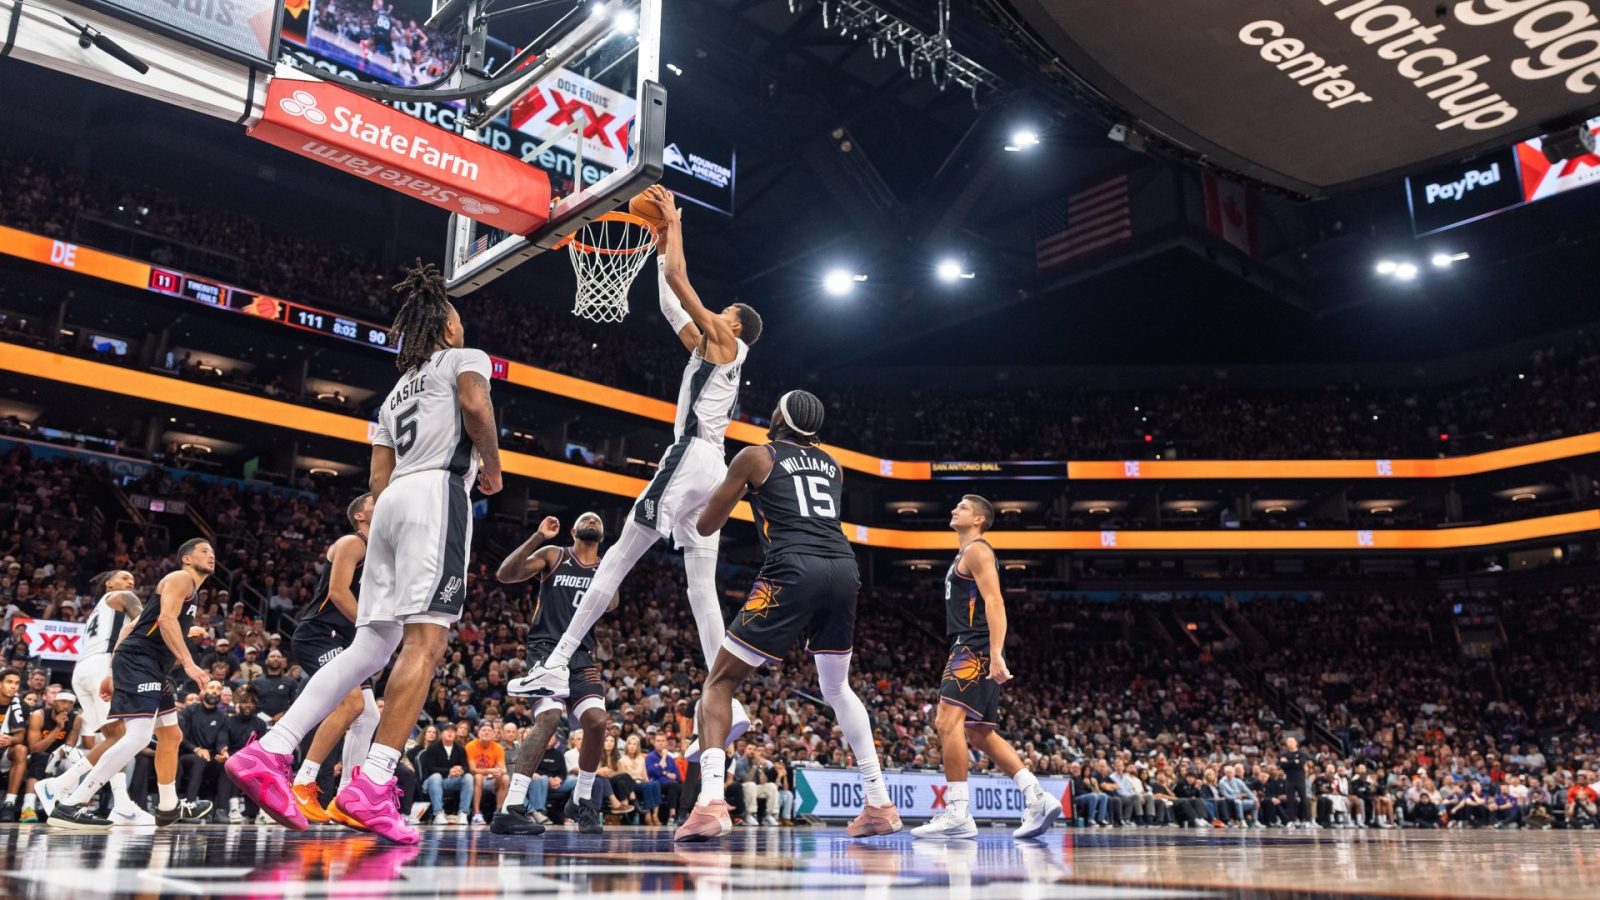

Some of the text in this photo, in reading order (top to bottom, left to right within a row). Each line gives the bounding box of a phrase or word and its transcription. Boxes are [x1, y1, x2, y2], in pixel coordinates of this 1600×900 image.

[1238, 19, 1373, 110] center
[557, 78, 609, 108] DOS EQUIS
[689, 153, 731, 179] MOUNTAIN
[1425, 162, 1501, 205] PayPal
[50, 239, 78, 267] DE
[158, 275, 170, 288] 11
[298, 311, 323, 329] 111
[333, 322, 357, 338] 8:02
[368, 329, 386, 345] 90
[390, 374, 427, 411] CASTLE
[394, 399, 420, 459] 5
[779, 456, 837, 479] WILLIAMS
[880, 459, 893, 476] DE
[1124, 460, 1140, 477] DE
[1376, 459, 1393, 476] DE
[792, 475, 837, 519] 15
[1101, 530, 1117, 547] DE
[1357, 529, 1375, 546] DE
[553, 574, 593, 589] PHOEN
[36, 632, 81, 655] XX
[830, 783, 863, 808] DOS
[975, 787, 1003, 810] DOS
[1005, 788, 1027, 812] EQ
